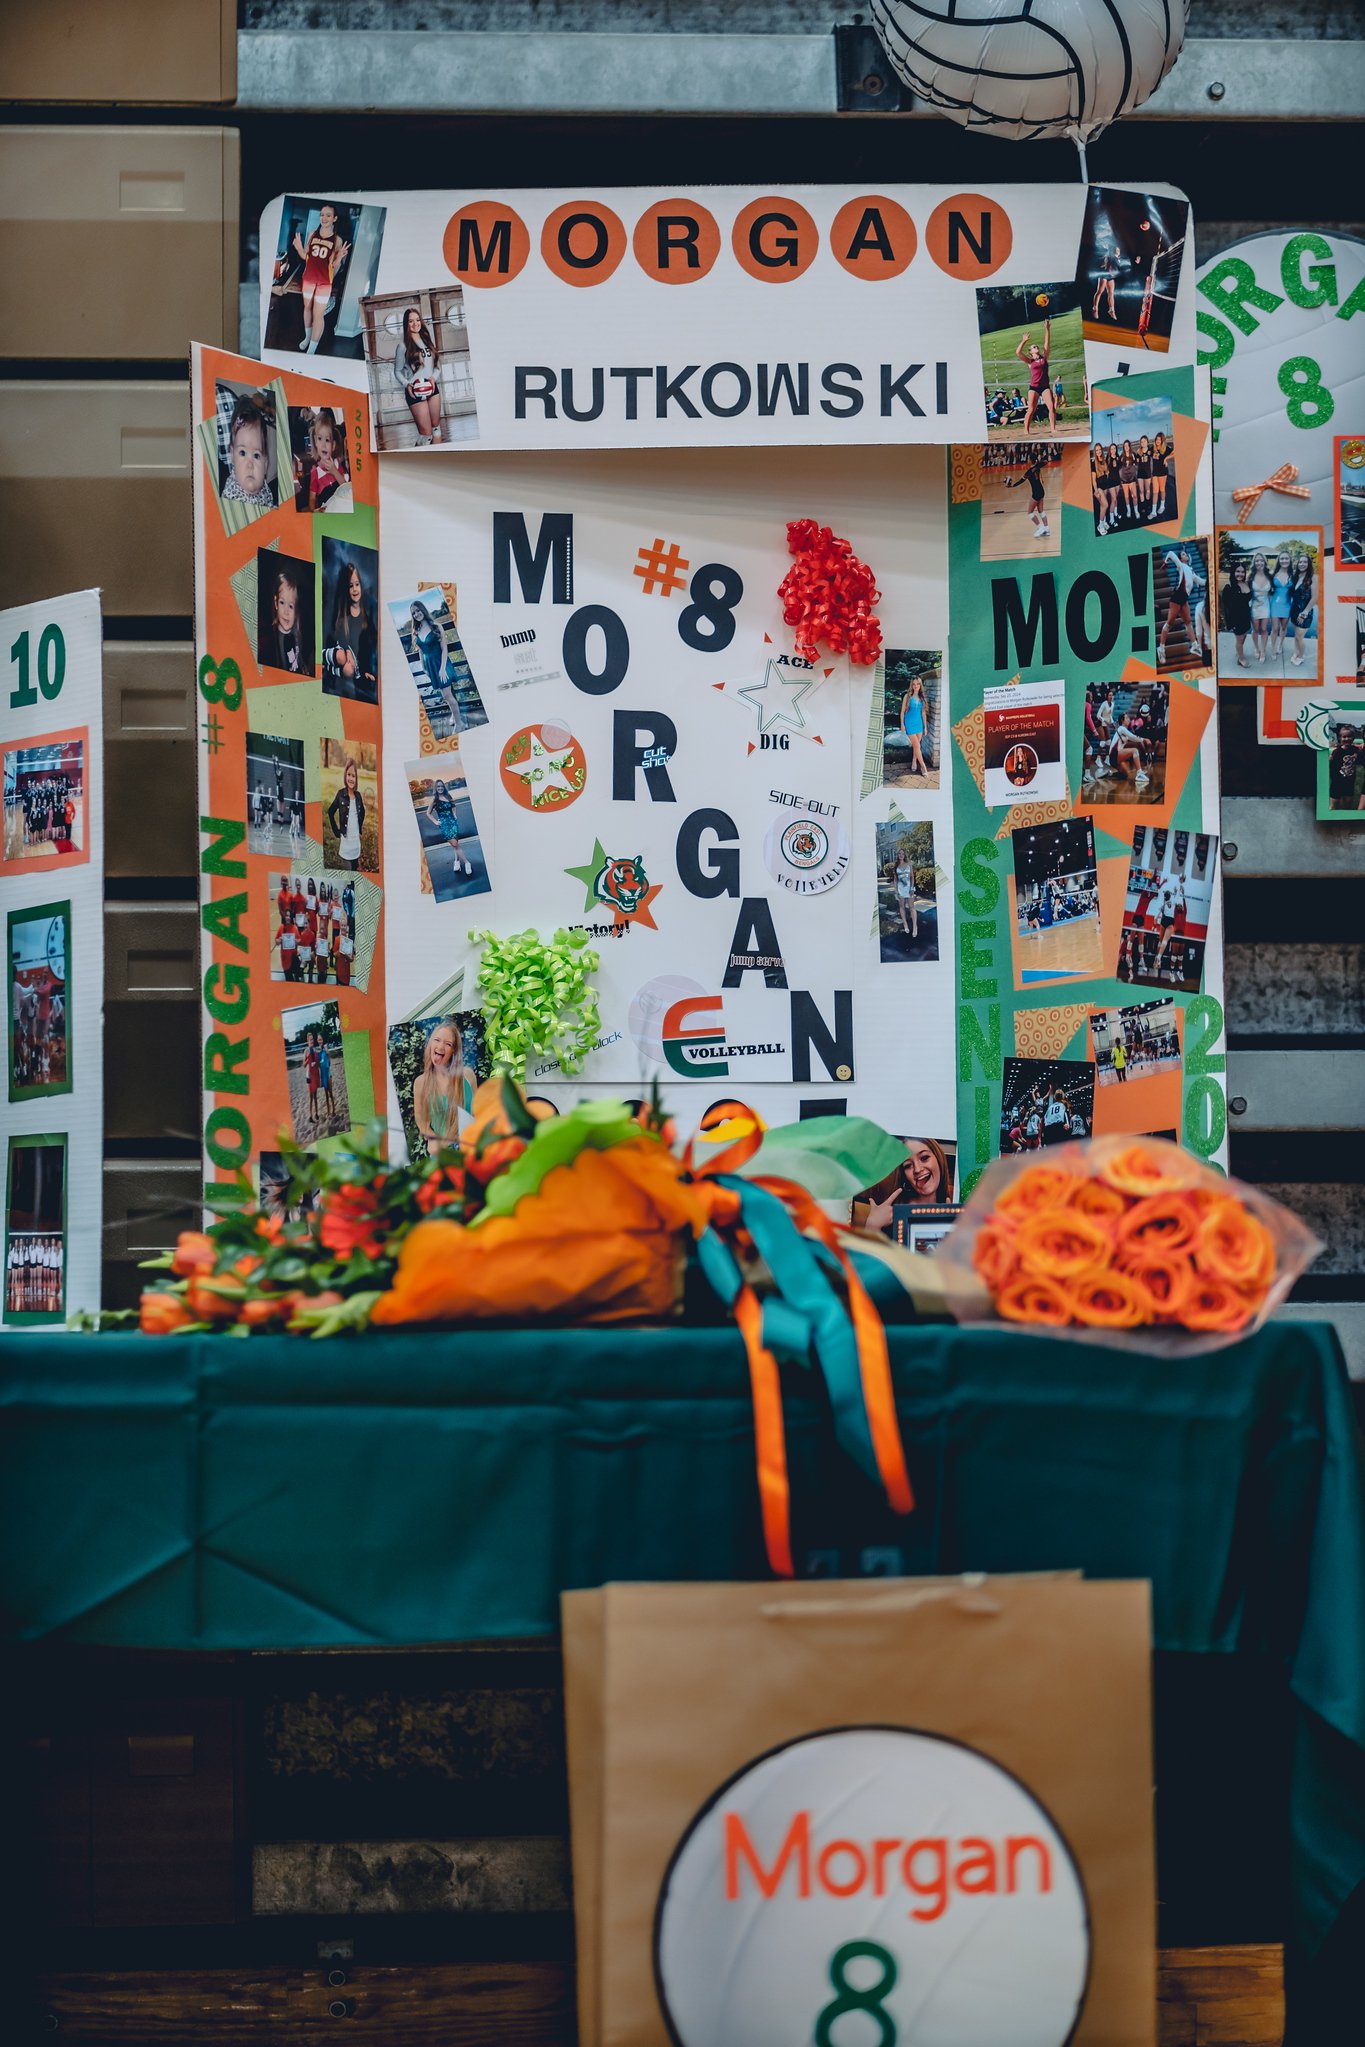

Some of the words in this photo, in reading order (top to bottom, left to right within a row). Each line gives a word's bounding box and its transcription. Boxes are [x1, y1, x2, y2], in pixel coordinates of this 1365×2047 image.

[457, 208, 992, 273] MORGAN
[312, 244, 328, 259] 30
[514, 362, 948, 421] RUTKOWSKI
[1277, 356, 1335, 429] 8
[991, 552, 1150, 671] MO!
[500, 629, 536, 648] bump
[10, 623, 66, 709] 10
[988, 724, 1010, 733] PLAYER
[1010, 723, 1019, 731] OF
[1020, 722, 1032, 730] THE
[1033, 720, 1054, 728] MATCH
[506, 734, 530, 766] ACE
[760, 734, 790, 750] DIG
[641, 755, 672, 769] shot
[643, 746, 667, 759] cut
[521, 768, 545, 785] GO
[532, 787, 570, 808] NICE
[570, 767, 585, 791] UP
[769, 789, 840, 817] SIDE-OUT
[784, 822, 809, 841] PLAINFIELD
[810, 824, 822, 836] EAST
[794, 856, 820, 866] BENGALS
[730, 953, 755, 967] jump
[756, 955, 787, 968] serve
[689, 1043, 785, 1059] VOLLEYBALL
[535, 1060, 561, 1077] clos
[723, 1811, 1053, 1923] Morgan
[814, 1940, 898, 2047] 8
